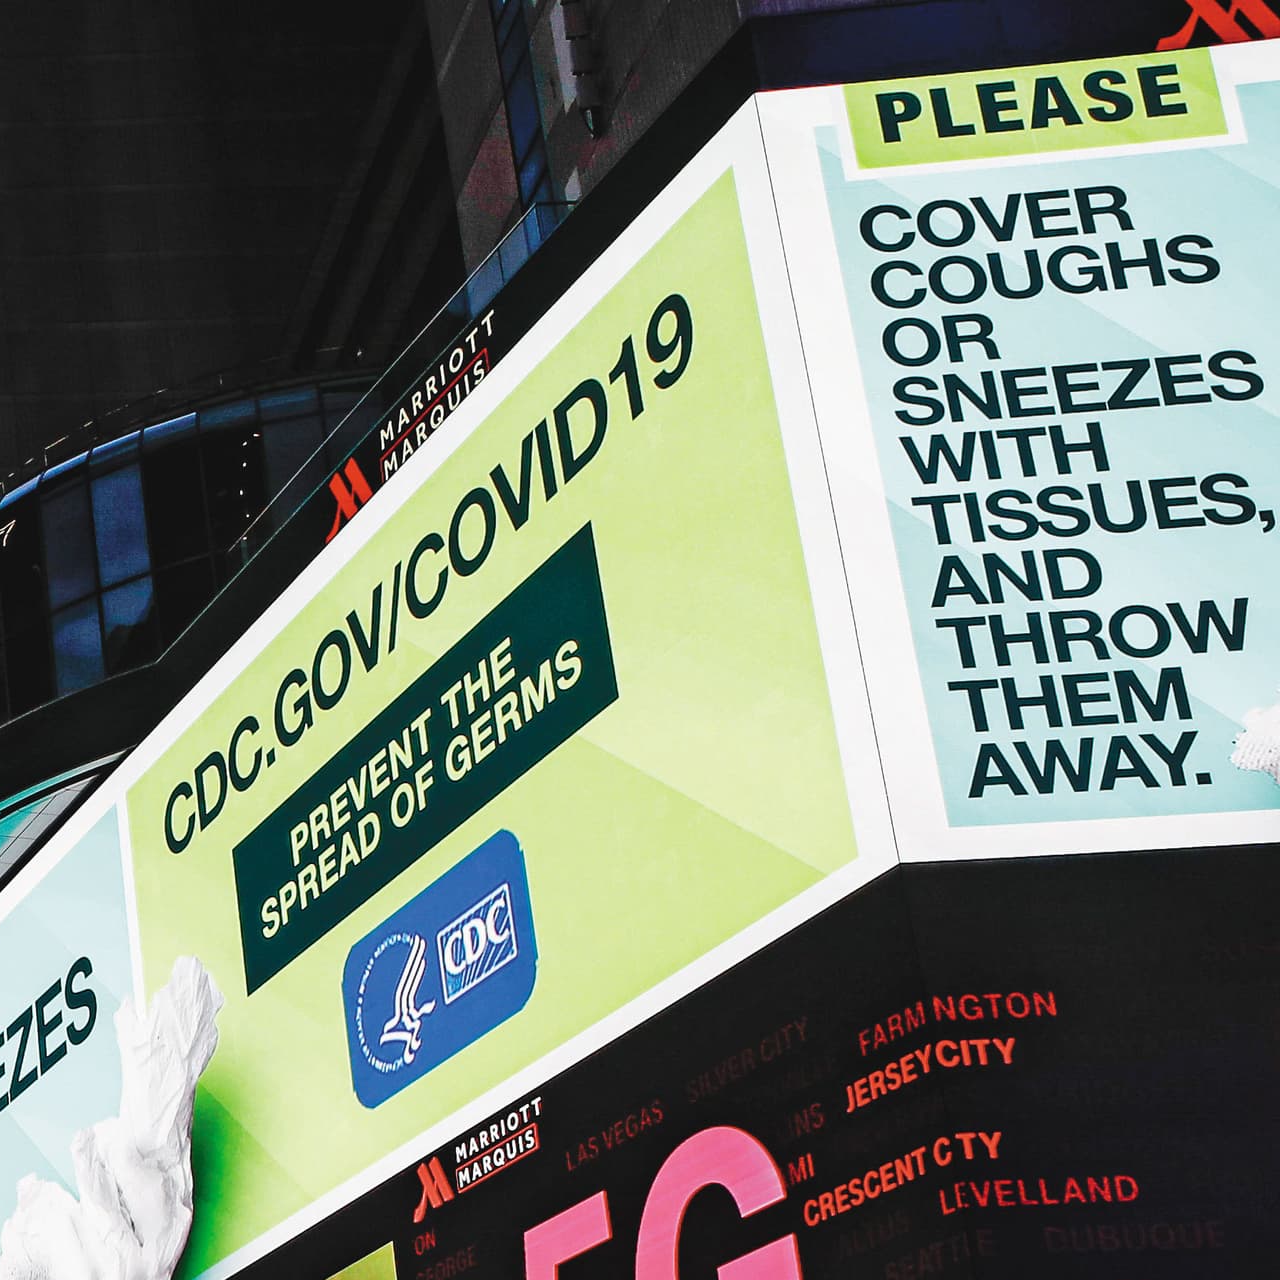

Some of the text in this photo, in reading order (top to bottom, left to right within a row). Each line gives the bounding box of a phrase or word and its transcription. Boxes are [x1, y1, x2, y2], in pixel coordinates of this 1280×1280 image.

[875, 64, 1189, 144] PLEASE
[859, 186, 1135, 253] COVER
[870, 234, 1221, 310] COUGHS
[882, 313, 1001, 367] OR
[380, 309, 495, 450] MARRIOTT
[892, 350, 1265, 426] SNEEZES
[383, 359, 485, 480] MARQUIS
[899, 422, 1110, 485] WITH
[911, 473, 1275, 545] TISSUES,
[163, 294, 693, 855] CDC.GOV/COVID19
[931, 548, 1103, 608] AND
[935, 598, 1248, 669] THROW
[948, 667, 1194, 732] THEM
[290, 636, 516, 867] PREVENT THE
[968, 731, 1213, 799] AWAY.
[260, 639, 583, 939] SPREAD OF GERMS
[443, 894, 510, 975] CDC
[845, 1037, 1016, 1113] JERSEY CITY
[456, 1097, 542, 1163] MARRIOTT
[457, 1129, 536, 1190] MARQUIS
[803, 1146, 927, 1227] CRESCENT
[939, 1175, 1140, 1216] LEVELLAND
